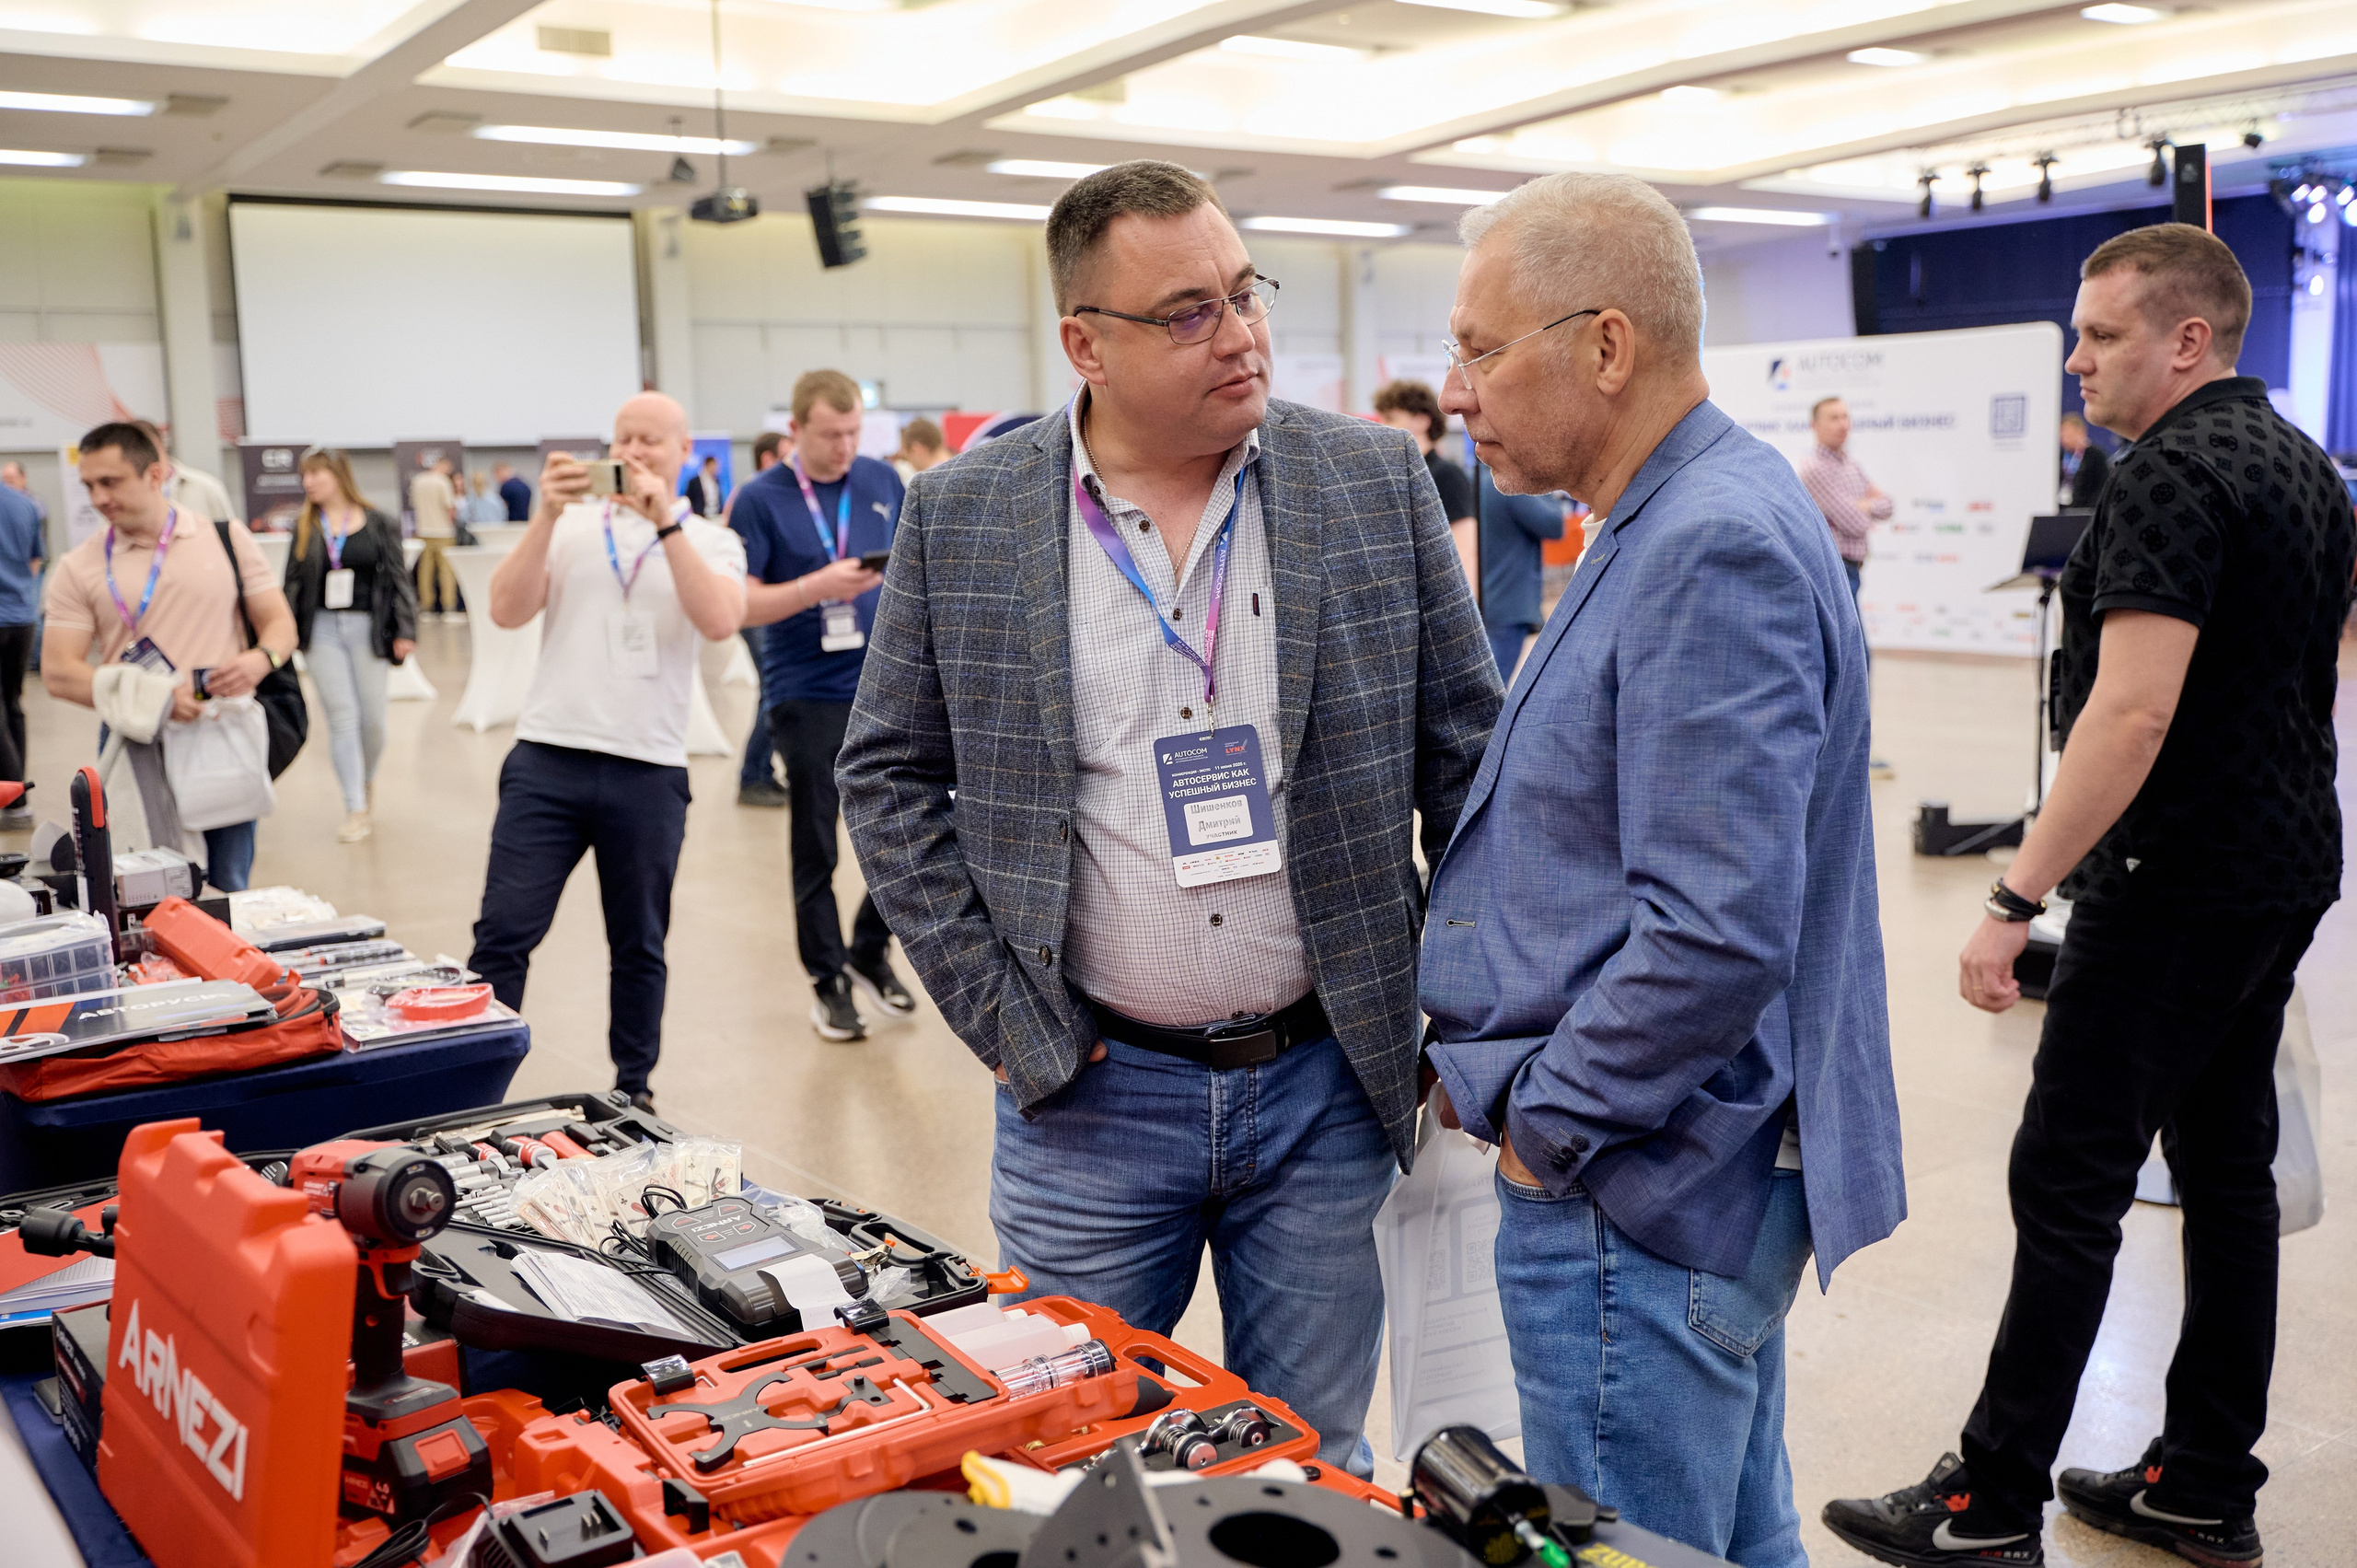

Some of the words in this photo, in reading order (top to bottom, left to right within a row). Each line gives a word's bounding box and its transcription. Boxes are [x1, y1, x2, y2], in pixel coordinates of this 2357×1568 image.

[1215, 549, 1226, 599] AUTOCOM
[1174, 747, 1208, 759] AUTOCOM
[1225, 745, 1246, 754] LYNX
[1172, 772, 1230, 788] АВТОСЕРВИС
[1231, 768, 1250, 777] КАК
[1168, 783, 1221, 799] УСПЕШНЫЙ
[1222, 777, 1257, 791] БИЗНЕС
[1190, 799, 1242, 815] Шишенков
[1198, 815, 1241, 832] Дмитрий
[691, 1214, 741, 1233] ARNEZI
[118, 1298, 249, 1503] ARNEZI
